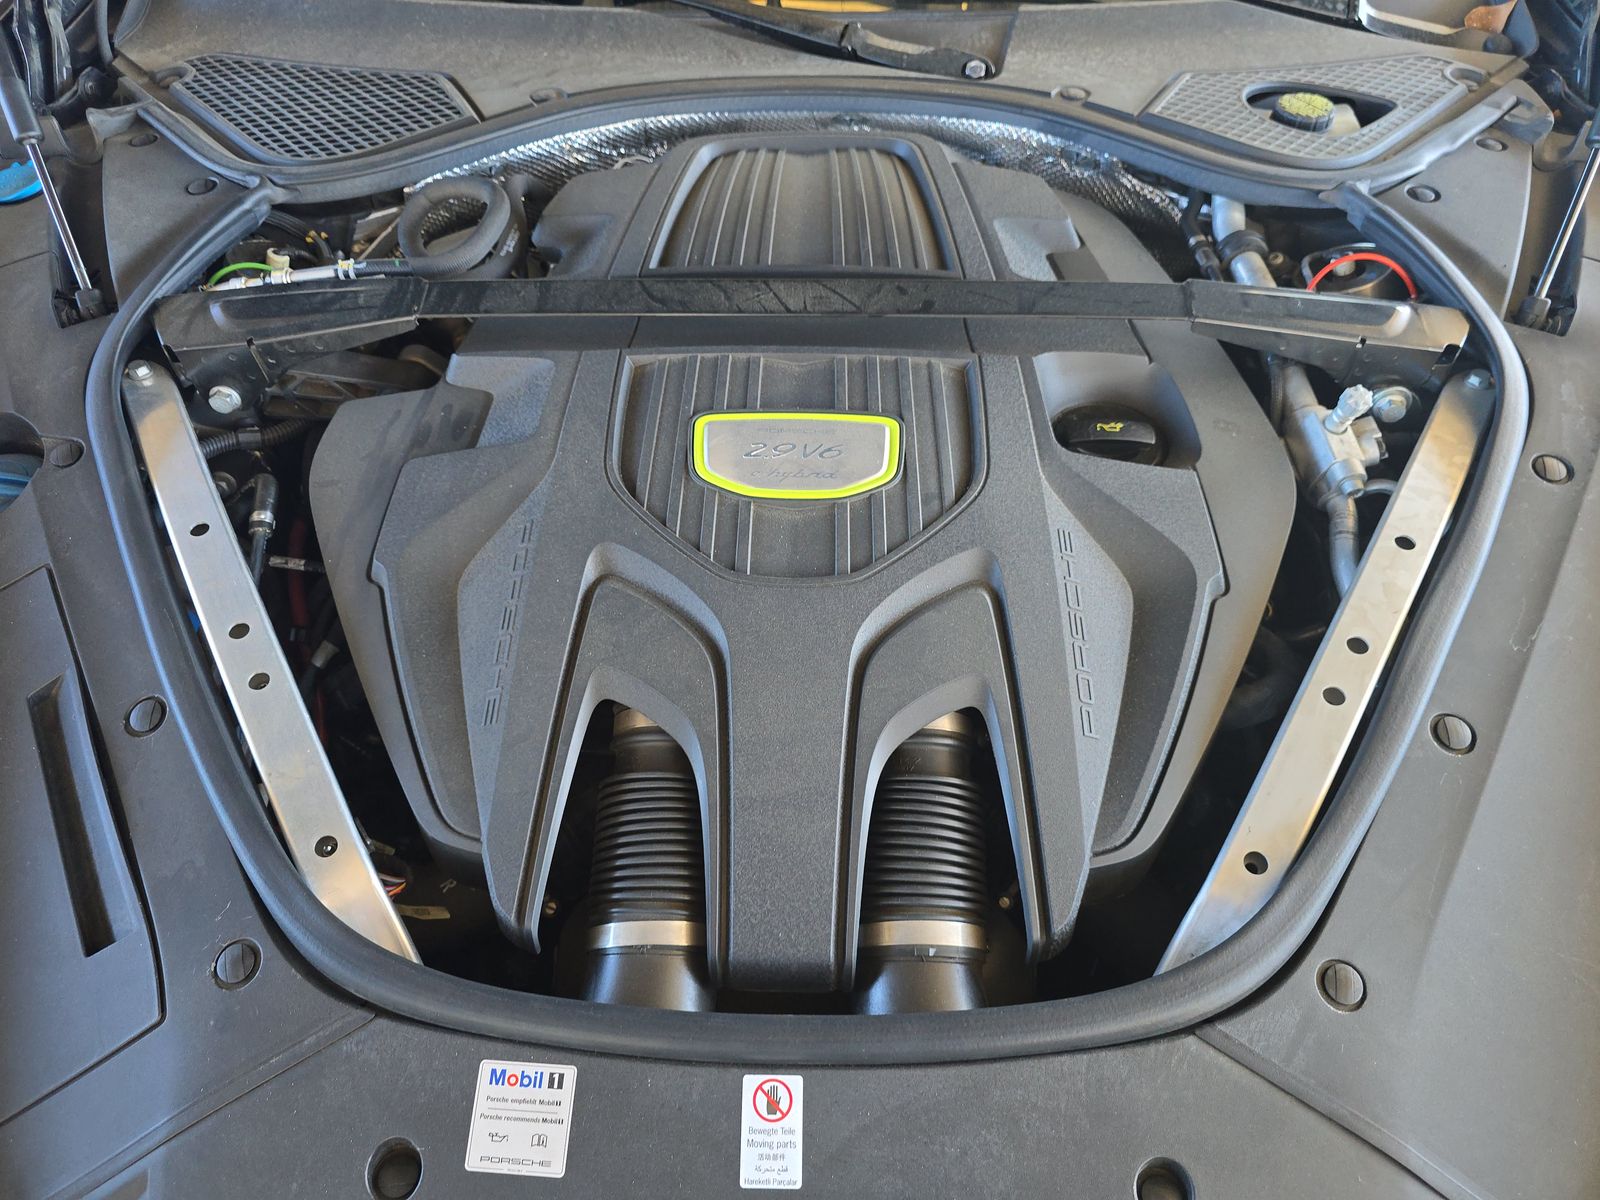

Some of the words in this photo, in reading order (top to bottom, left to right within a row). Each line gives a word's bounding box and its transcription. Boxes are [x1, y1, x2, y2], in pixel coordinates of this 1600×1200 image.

[802, 442, 844, 459] V6
[1056, 528, 1100, 739] PORSCHE
[489, 1068, 544, 1089] Mobil
[486, 1095, 509, 1103] Porsche
[479, 1112, 503, 1121] Porsche
[503, 1115, 541, 1124] recommends
[748, 1126, 779, 1136] Bewegte
[780, 1126, 796, 1135] Teile
[746, 1138, 774, 1150] Moving
[776, 1139, 797, 1150] parts
[480, 1155, 552, 1168] PORSCHE
[744, 1177, 771, 1186] Hareketli
